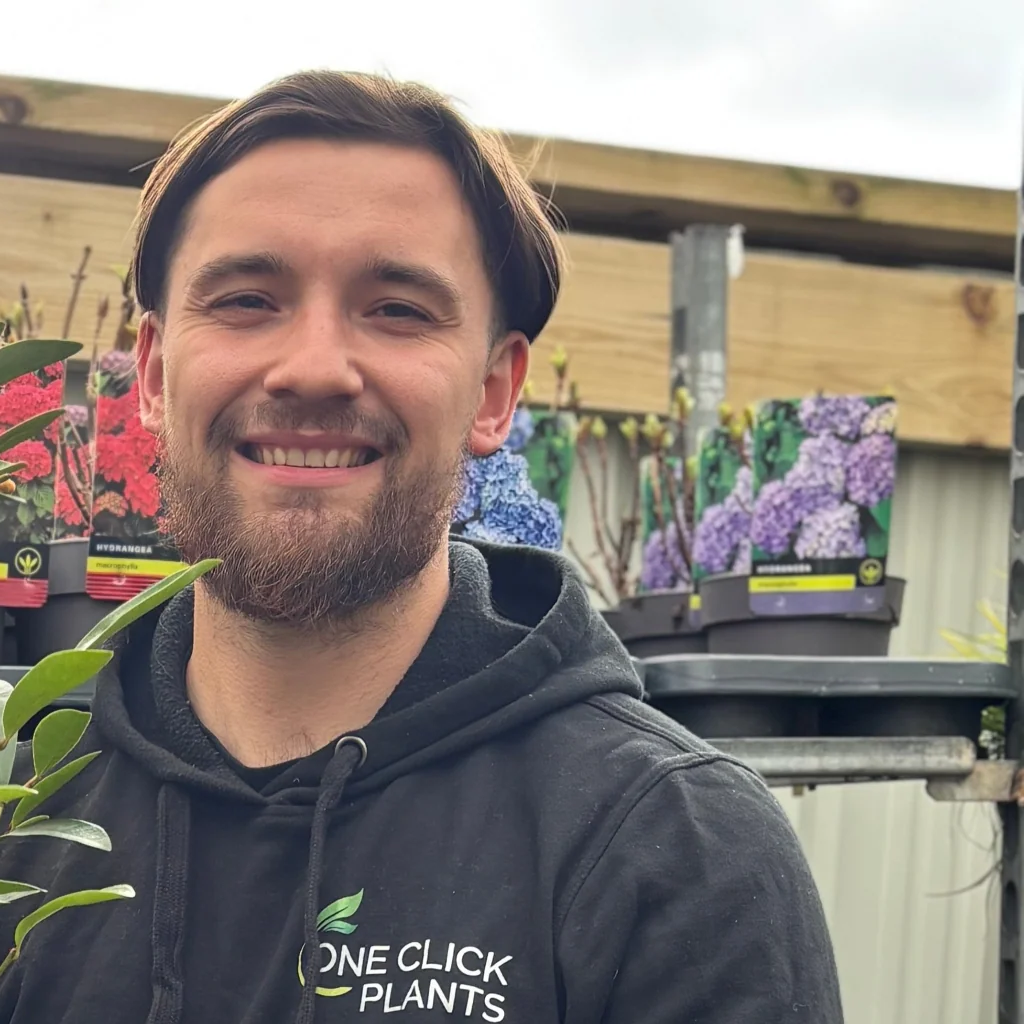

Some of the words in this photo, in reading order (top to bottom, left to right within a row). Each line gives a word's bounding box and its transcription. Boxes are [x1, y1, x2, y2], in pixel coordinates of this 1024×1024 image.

[96, 544, 153, 554] HYDRANGEA
[397, 938, 513, 986] CLICK
[359, 978, 506, 1023] PLANTS
